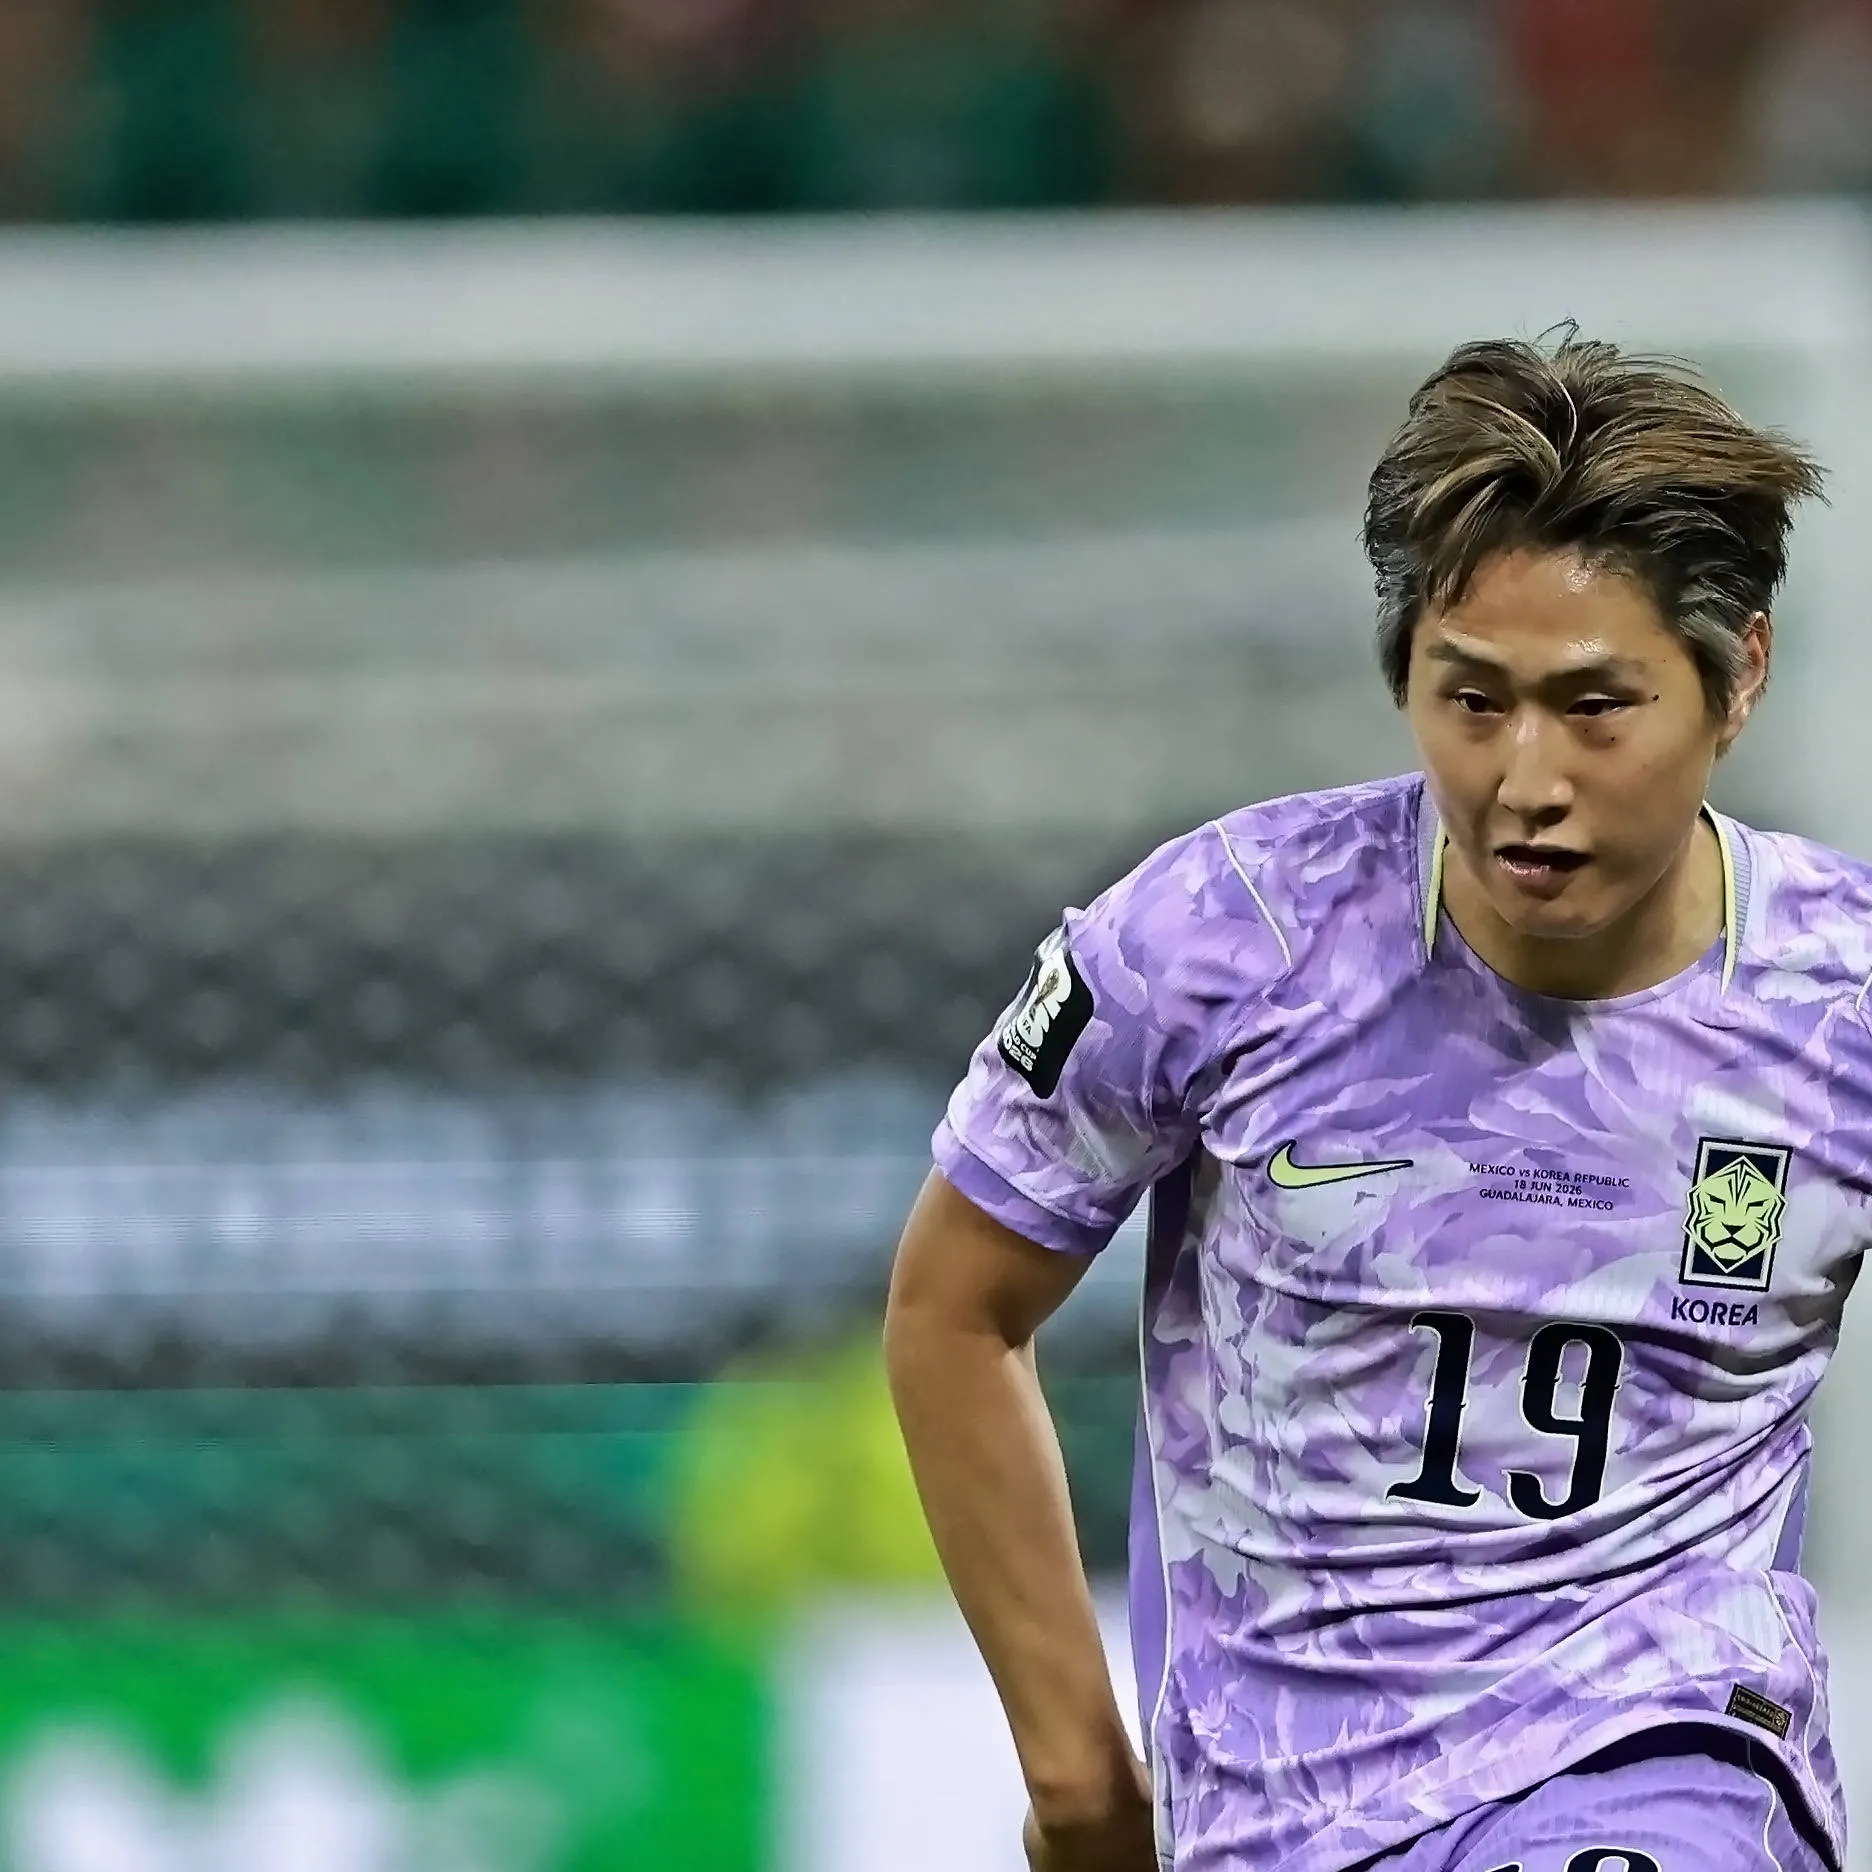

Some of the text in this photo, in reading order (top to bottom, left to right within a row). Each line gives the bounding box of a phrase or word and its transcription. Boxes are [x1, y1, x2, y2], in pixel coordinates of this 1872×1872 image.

[1469, 1163, 1516, 1176] MEXICO
[1534, 1169, 1570, 1182] KOREA
[1574, 1173, 1630, 1188] REPUBLIC
[1514, 1179, 1582, 1195] 18 JUN 2026
[1479, 1188, 1614, 1211] GUADALAJARA, MEXICO
[1670, 1296, 1760, 1327] KOREA
[1385, 1310, 1626, 1521] 19
